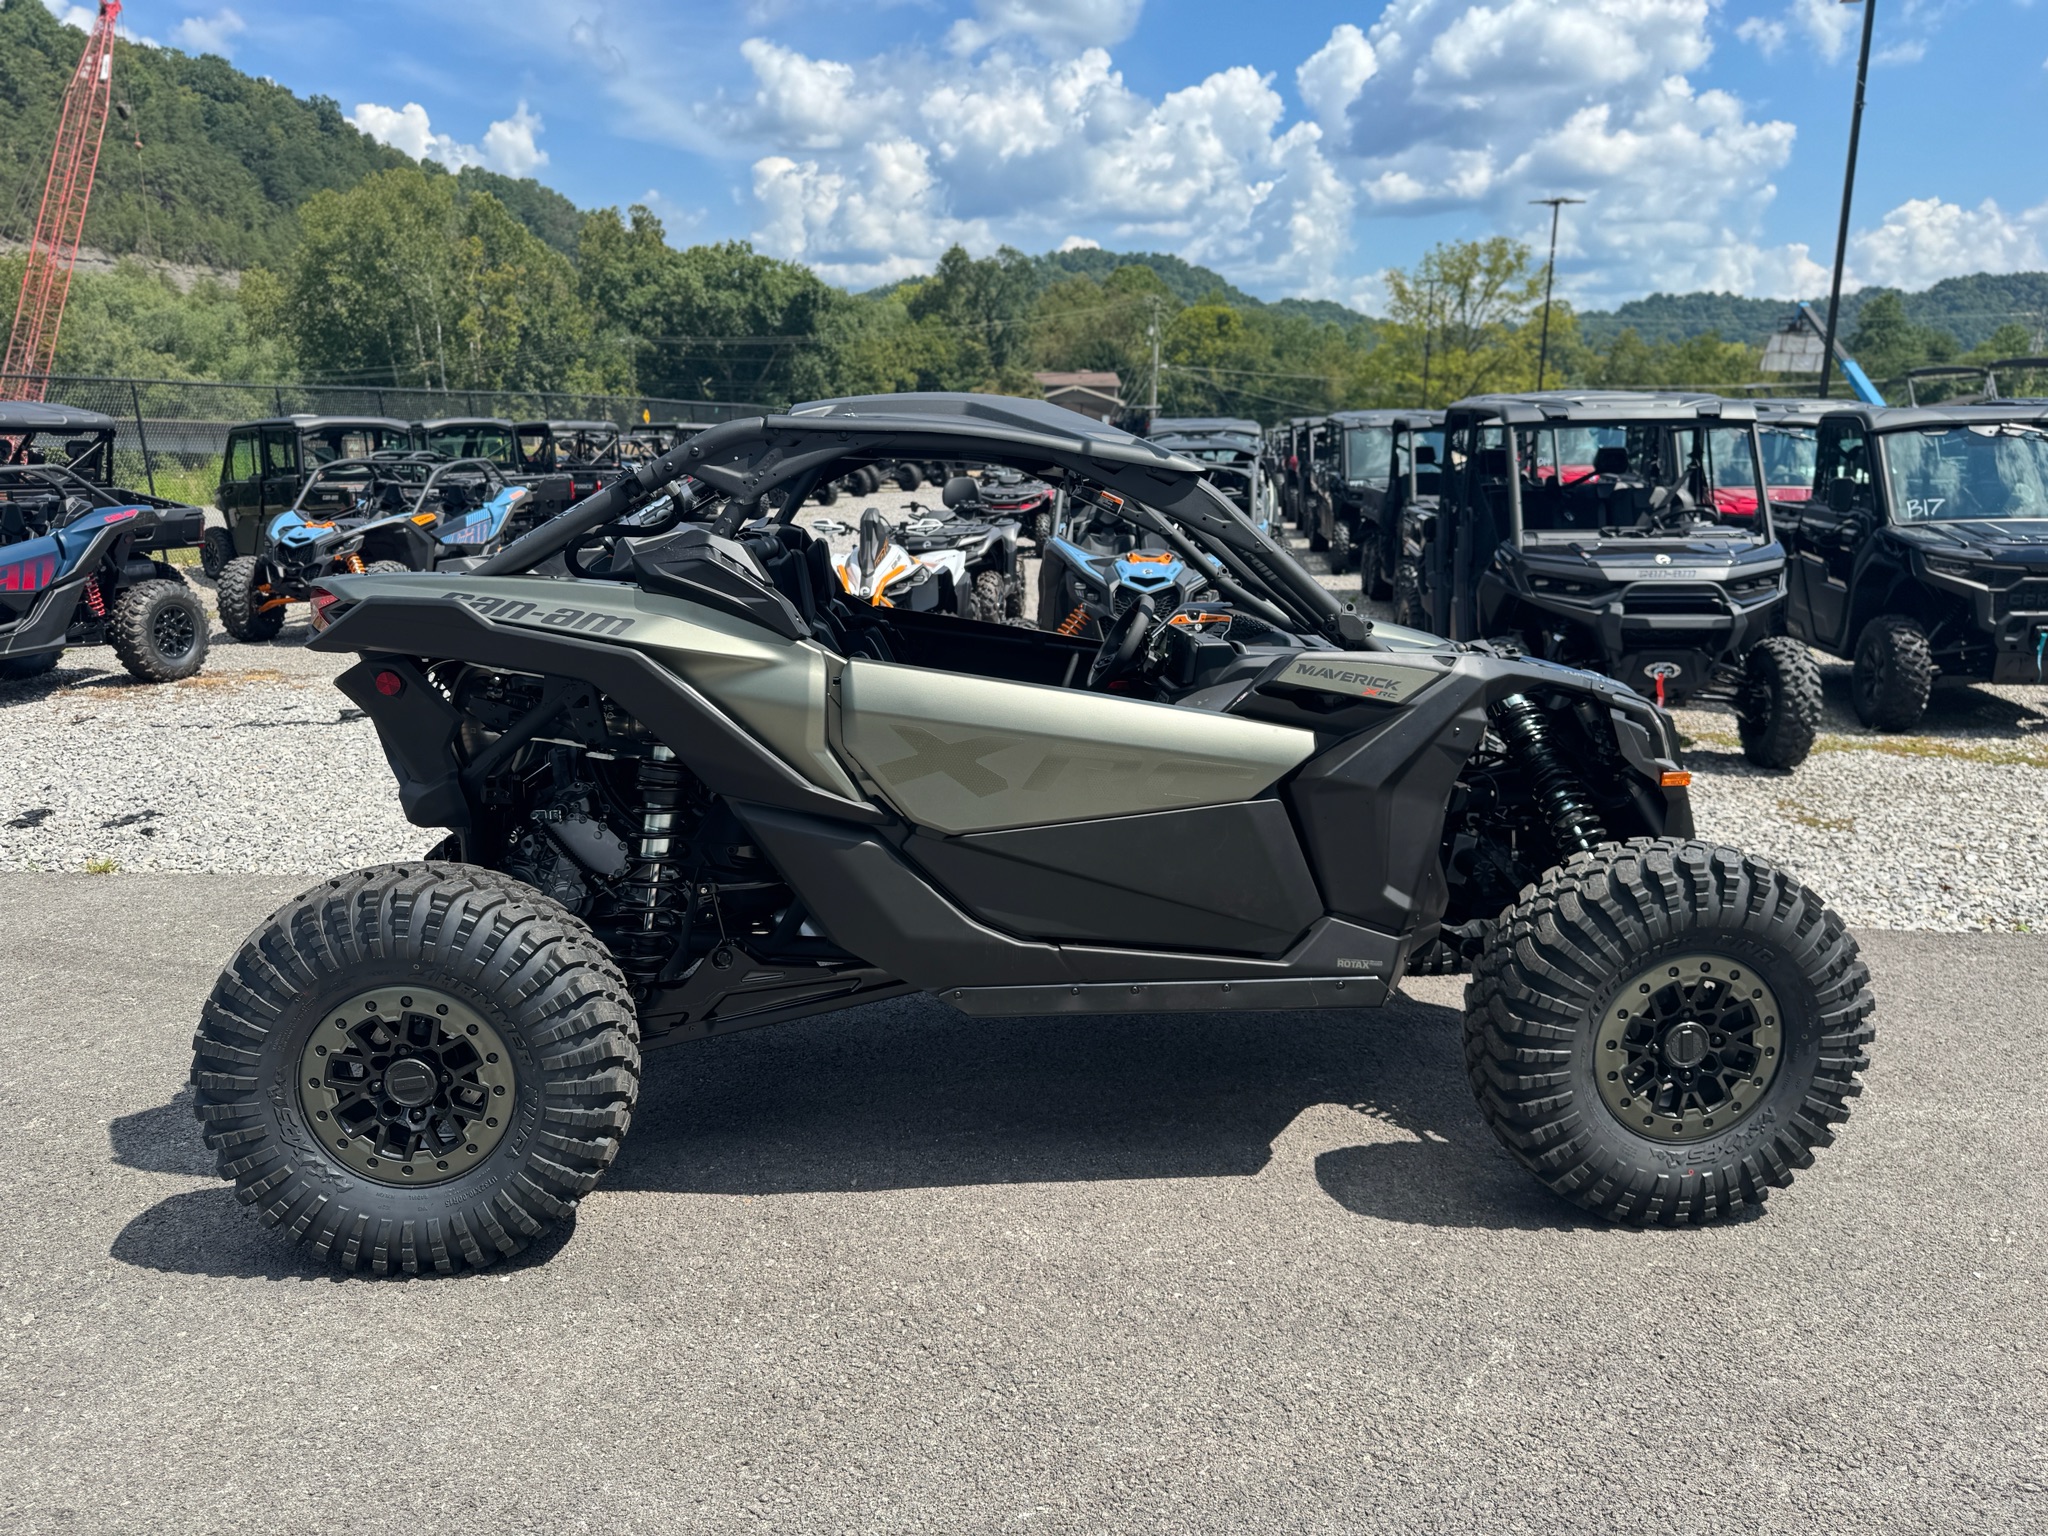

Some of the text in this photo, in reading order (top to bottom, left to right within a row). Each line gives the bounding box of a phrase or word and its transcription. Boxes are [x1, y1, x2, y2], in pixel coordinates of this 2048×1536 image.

[1907, 498, 1946, 519] B17
[1296, 663, 1402, 691] MAVERICK
[1362, 687, 1398, 699] XRC
[876, 724, 1258, 800] XRC
[1337, 958, 1370, 969] ROTAX
